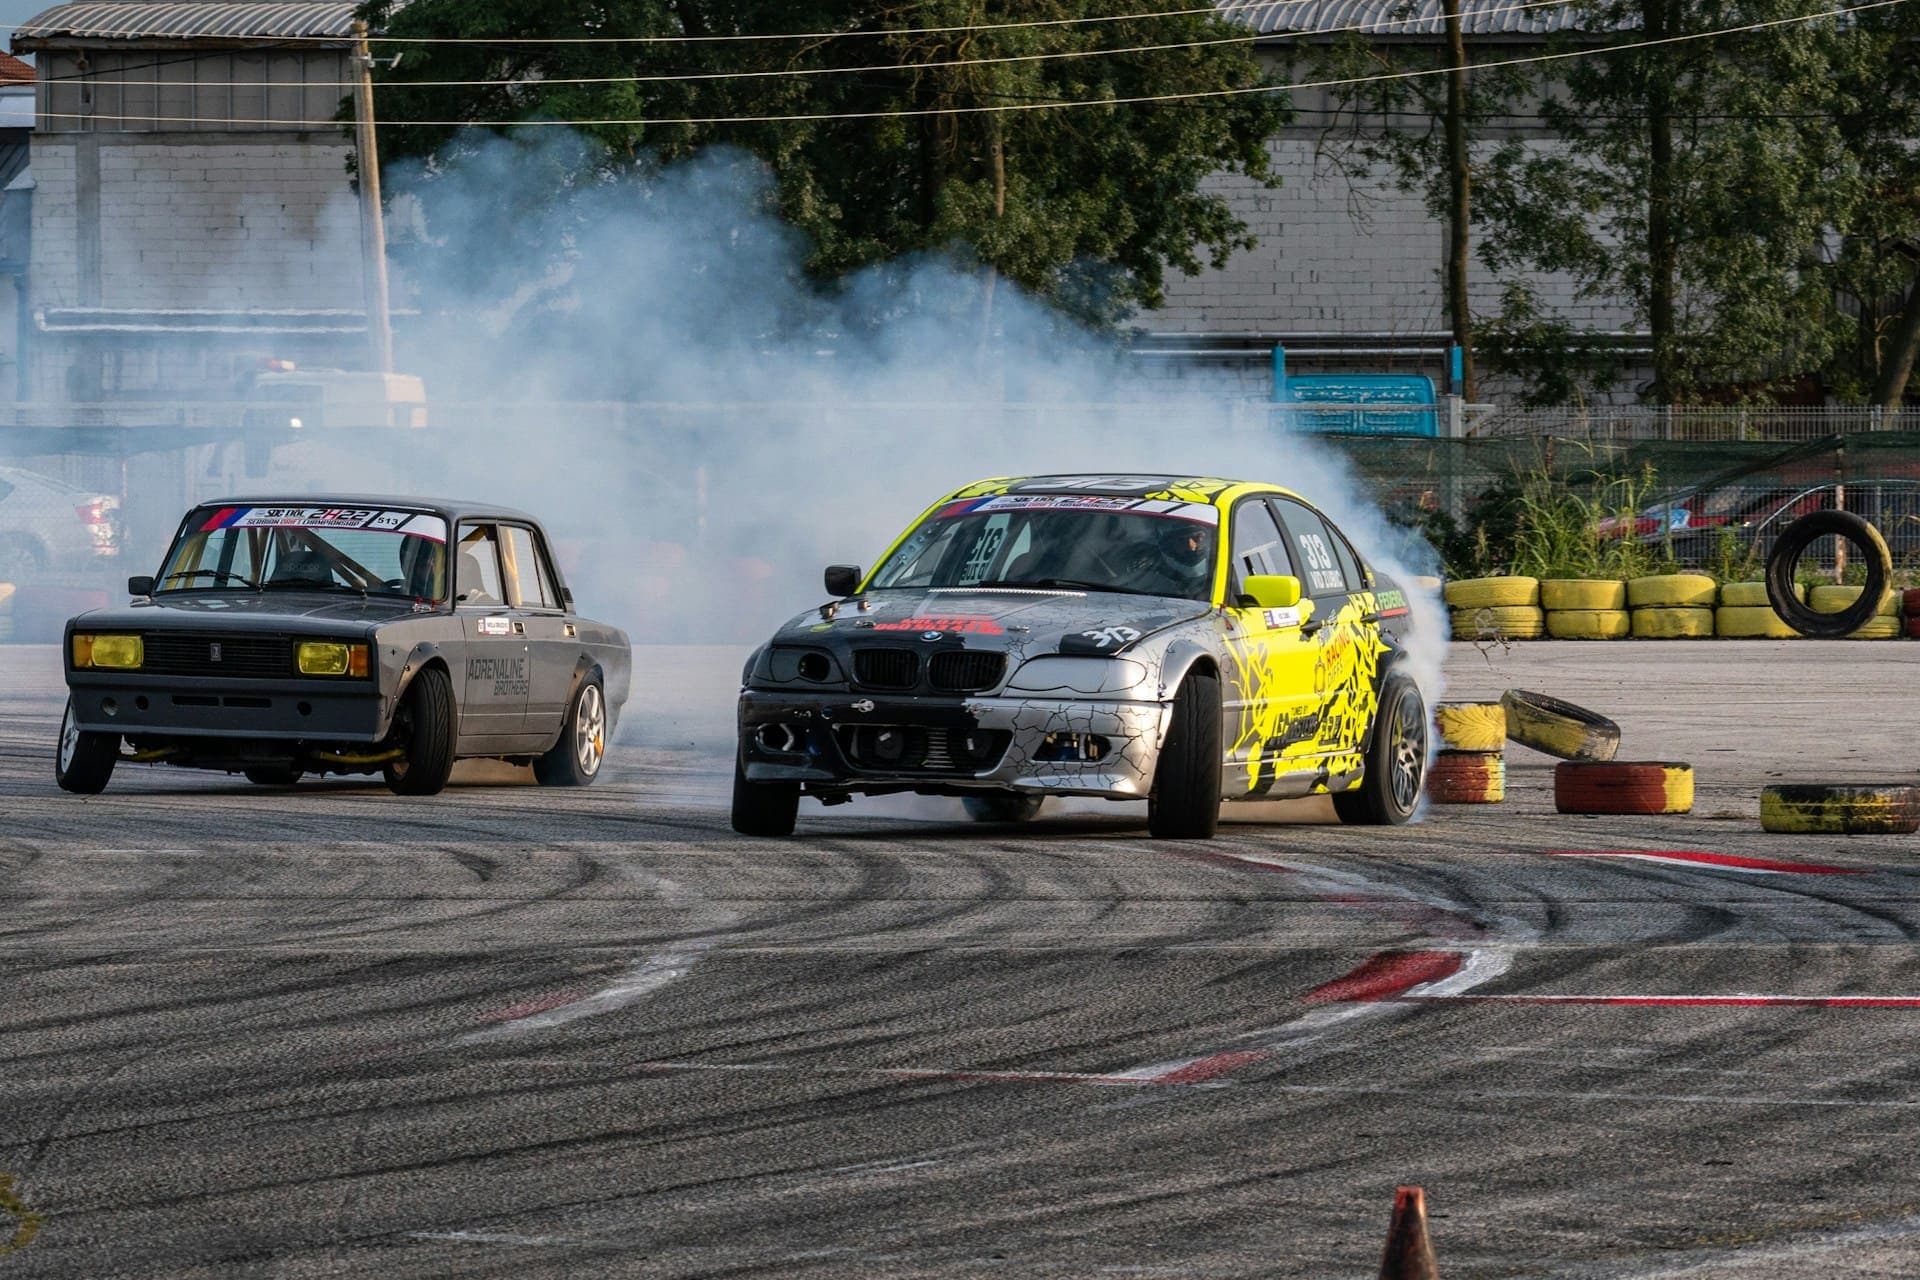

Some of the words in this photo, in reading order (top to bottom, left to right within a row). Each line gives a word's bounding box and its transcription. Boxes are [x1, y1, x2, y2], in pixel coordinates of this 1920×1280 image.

[302, 519, 360, 527] CHAMPIONSHIP
[377, 517, 398, 525] 513
[1299, 534, 1332, 569] 313
[1377, 590, 1406, 611] FEDERAL
[1081, 626, 1141, 648] 313
[1326, 627, 1351, 669] RACING
[468, 658, 525, 680] ADRENALINE
[493, 680, 528, 696] BROTHERS
